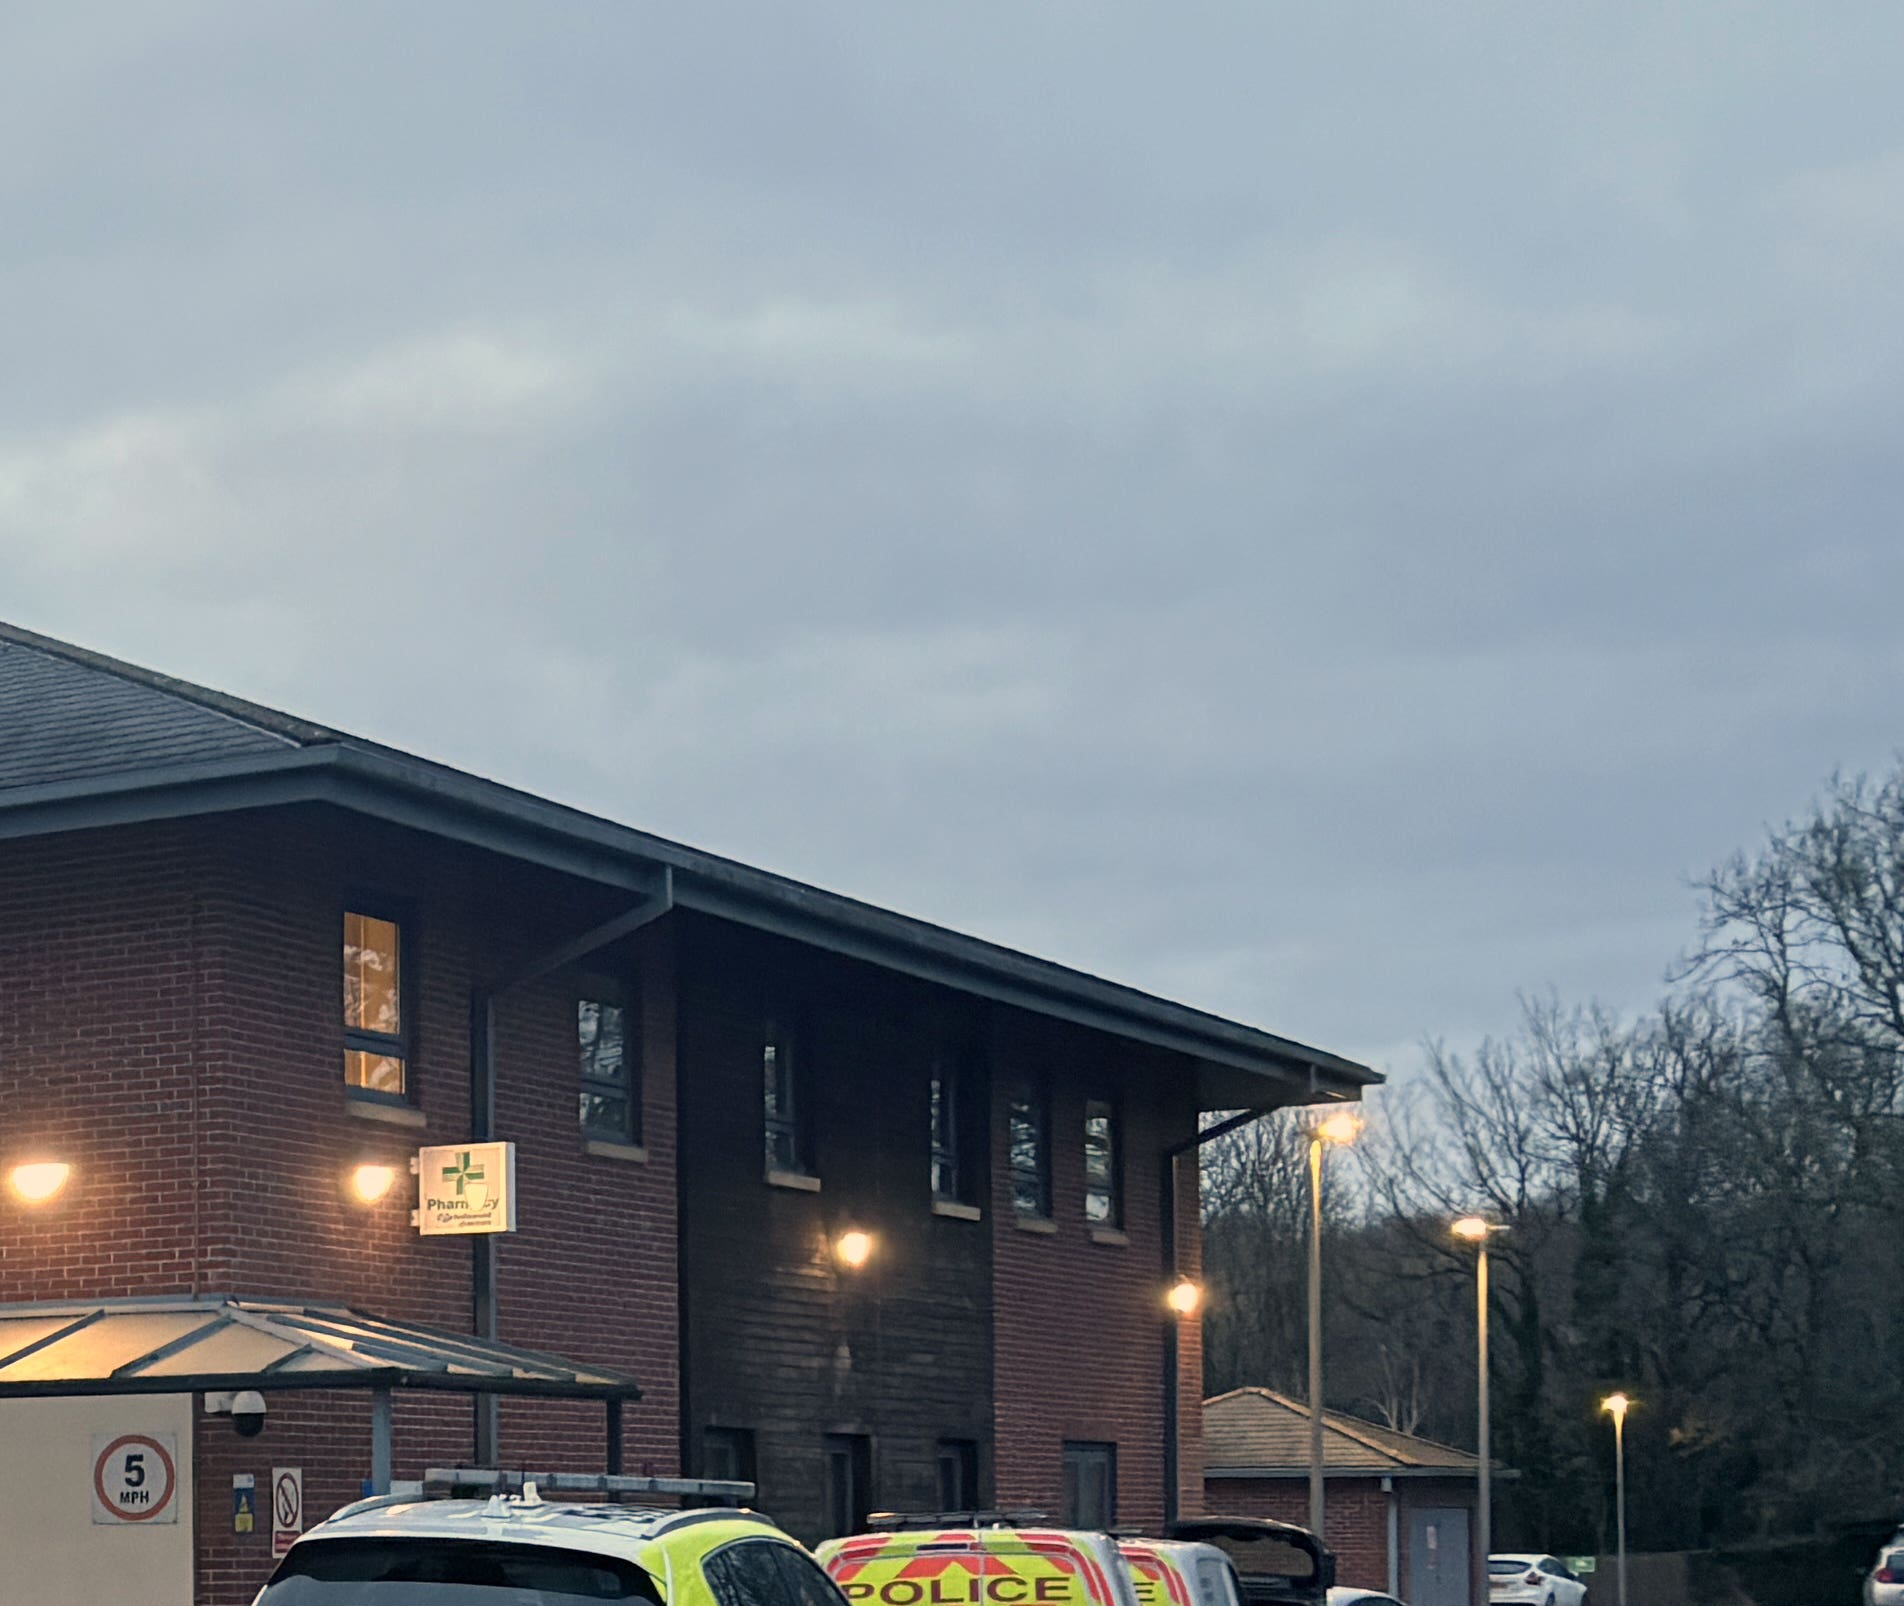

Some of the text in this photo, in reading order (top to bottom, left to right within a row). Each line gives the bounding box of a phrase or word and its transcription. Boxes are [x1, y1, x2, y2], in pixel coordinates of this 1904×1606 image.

[426, 1198, 499, 1210] Pharmcy
[124, 1454, 145, 1488] 5
[120, 1490, 150, 1505] MPH
[840, 1576, 1072, 1605] POLICE
